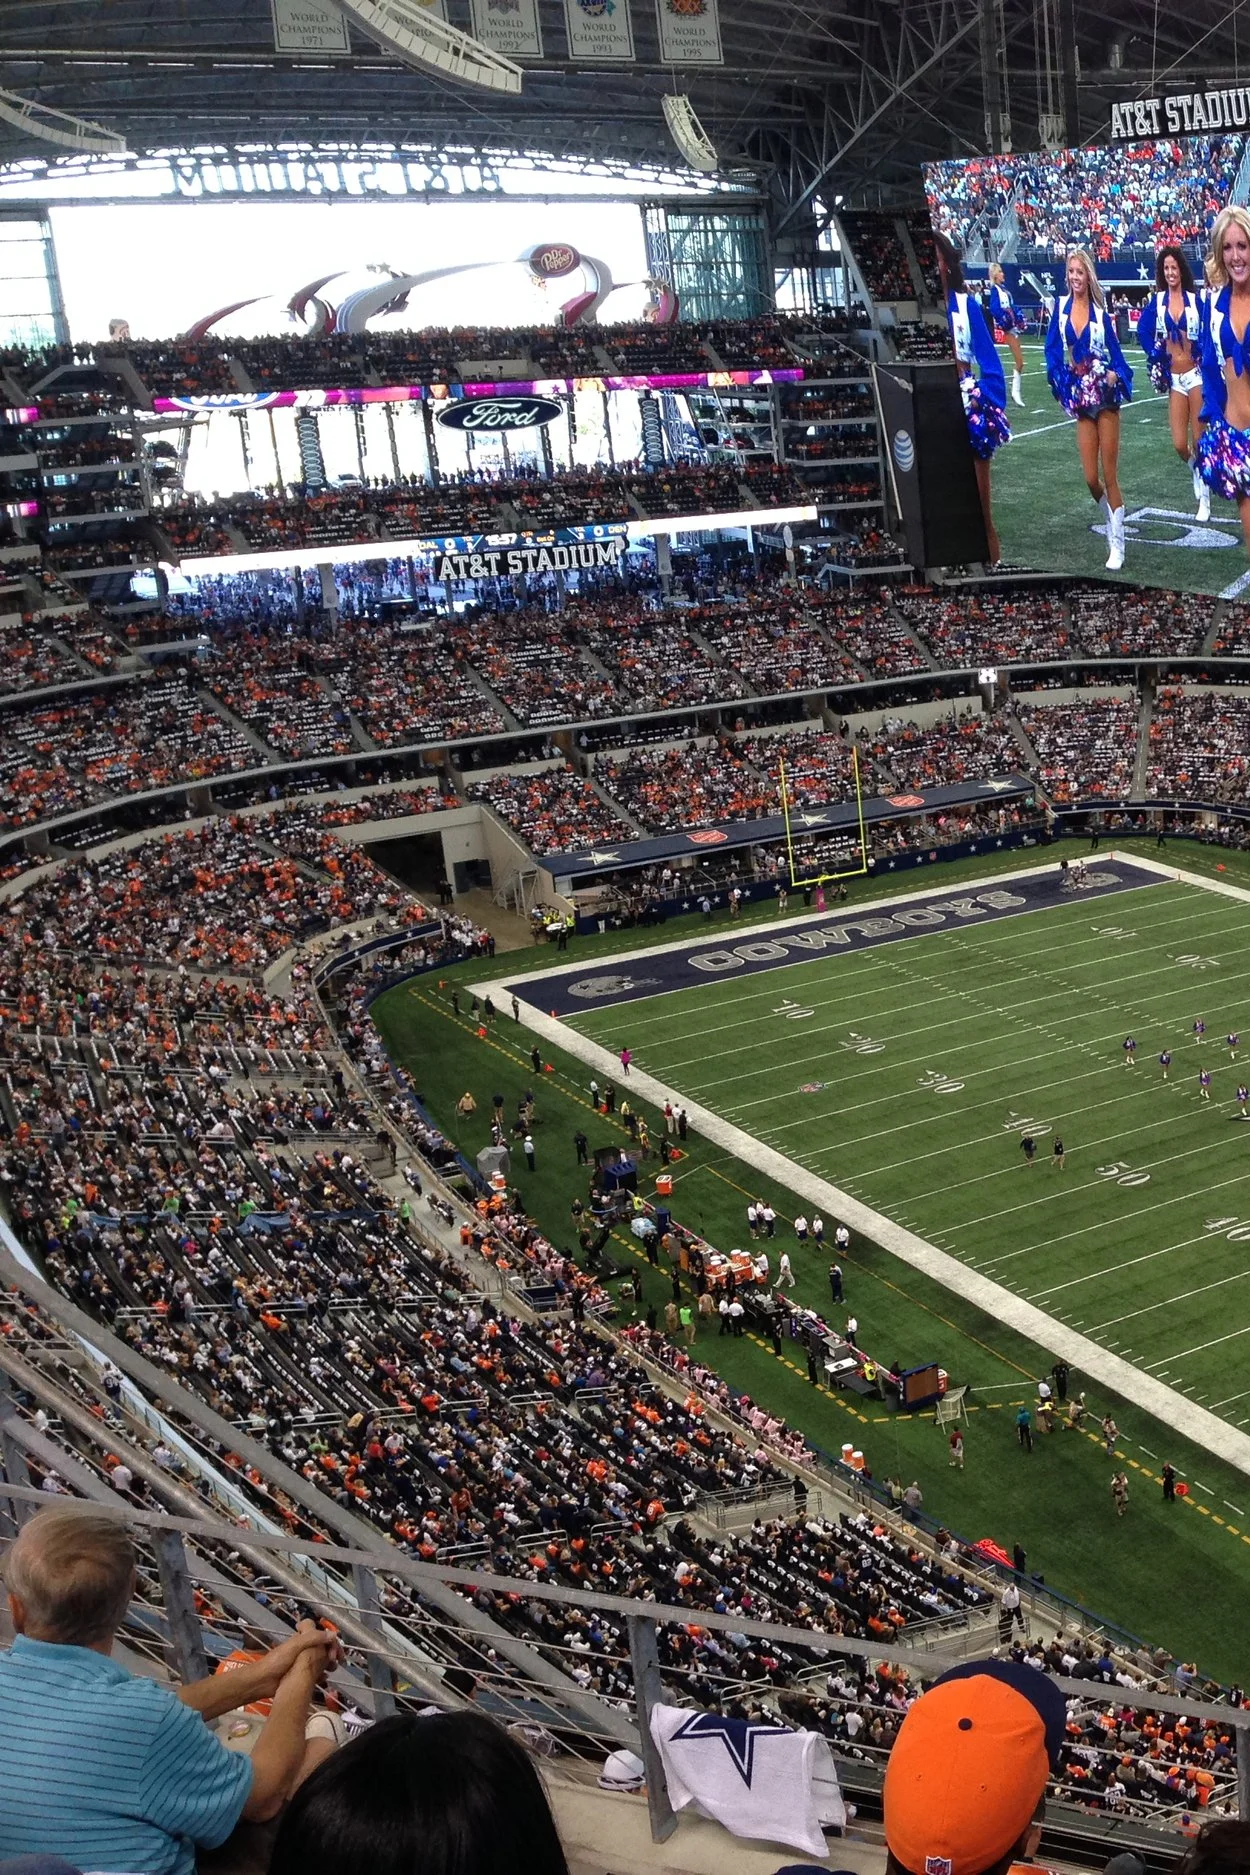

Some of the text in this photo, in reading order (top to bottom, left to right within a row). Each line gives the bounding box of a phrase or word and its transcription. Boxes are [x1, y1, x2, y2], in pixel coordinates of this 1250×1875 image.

[290, 12, 329, 22] WORLD
[488, 18, 524, 28] WORLD
[582, 23, 617, 32] WORLD
[279, 24, 342, 35] CHAMPIONS
[478, 29, 536, 40] CHAMPIONS
[673, 27, 706, 36] WORLD
[301, 36, 323, 46] 1971
[573, 33, 628, 43] CHAMPIONS
[664, 37, 717, 47] CHAMPIONS
[499, 40, 520, 50] 1992
[682, 48, 702, 57] 1995
[1111, 99, 1161, 138] AT&T
[551, 249, 563, 258] Dr
[543, 251, 570, 271] Pepper
[462, 402, 540, 427] Ford
[593, 525, 604, 536] 0
[608, 525, 627, 534] DEN
[445, 538, 456, 549] 0
[438, 541, 618, 581] AT&T STADIUM
[688, 890, 1026, 972] COWBOYS
[772, 1002, 815, 1019] 10
[838, 1036, 886, 1054] 20
[915, 1073, 966, 1094] 30
[1001, 1117, 1053, 1137] 40
[1095, 1161, 1151, 1186] 50
